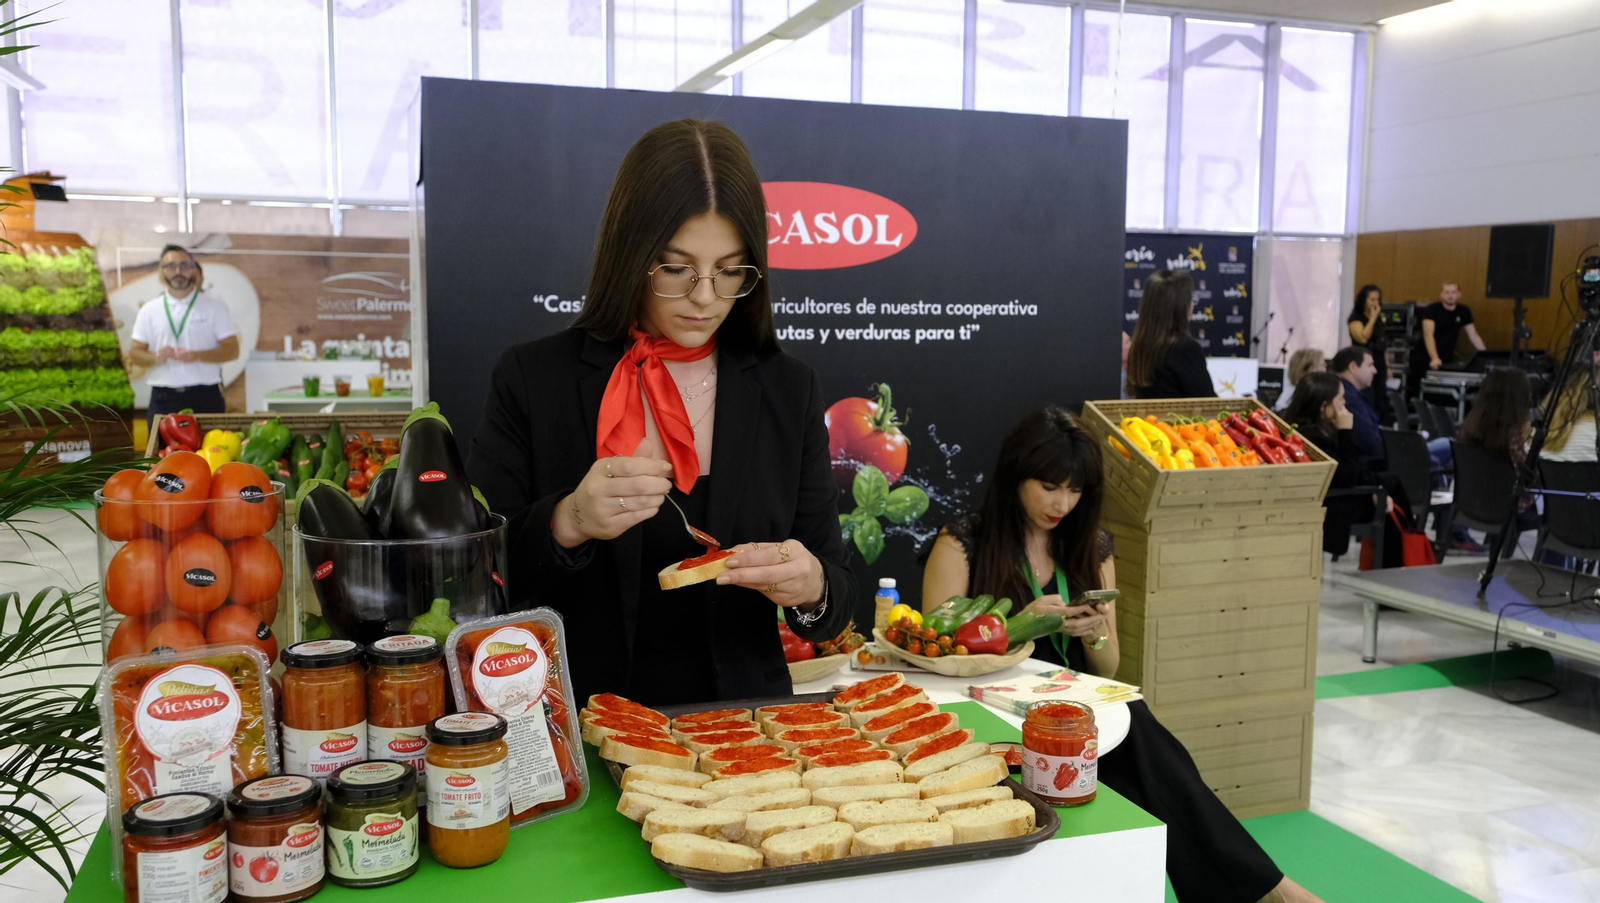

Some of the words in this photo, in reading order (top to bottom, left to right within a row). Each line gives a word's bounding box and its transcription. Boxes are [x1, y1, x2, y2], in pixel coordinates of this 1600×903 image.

[855, 297, 877, 315] de
[880, 300, 942, 316] nuestra
[945, 299, 1038, 320] cooperativa
[818, 328, 831, 345] y
[834, 322, 911, 341] verduras
[915, 328, 955, 345] para
[310, 762, 339, 773] TOMATE
[441, 792, 463, 801] TOMATE
[464, 792, 482, 800] FRITO
